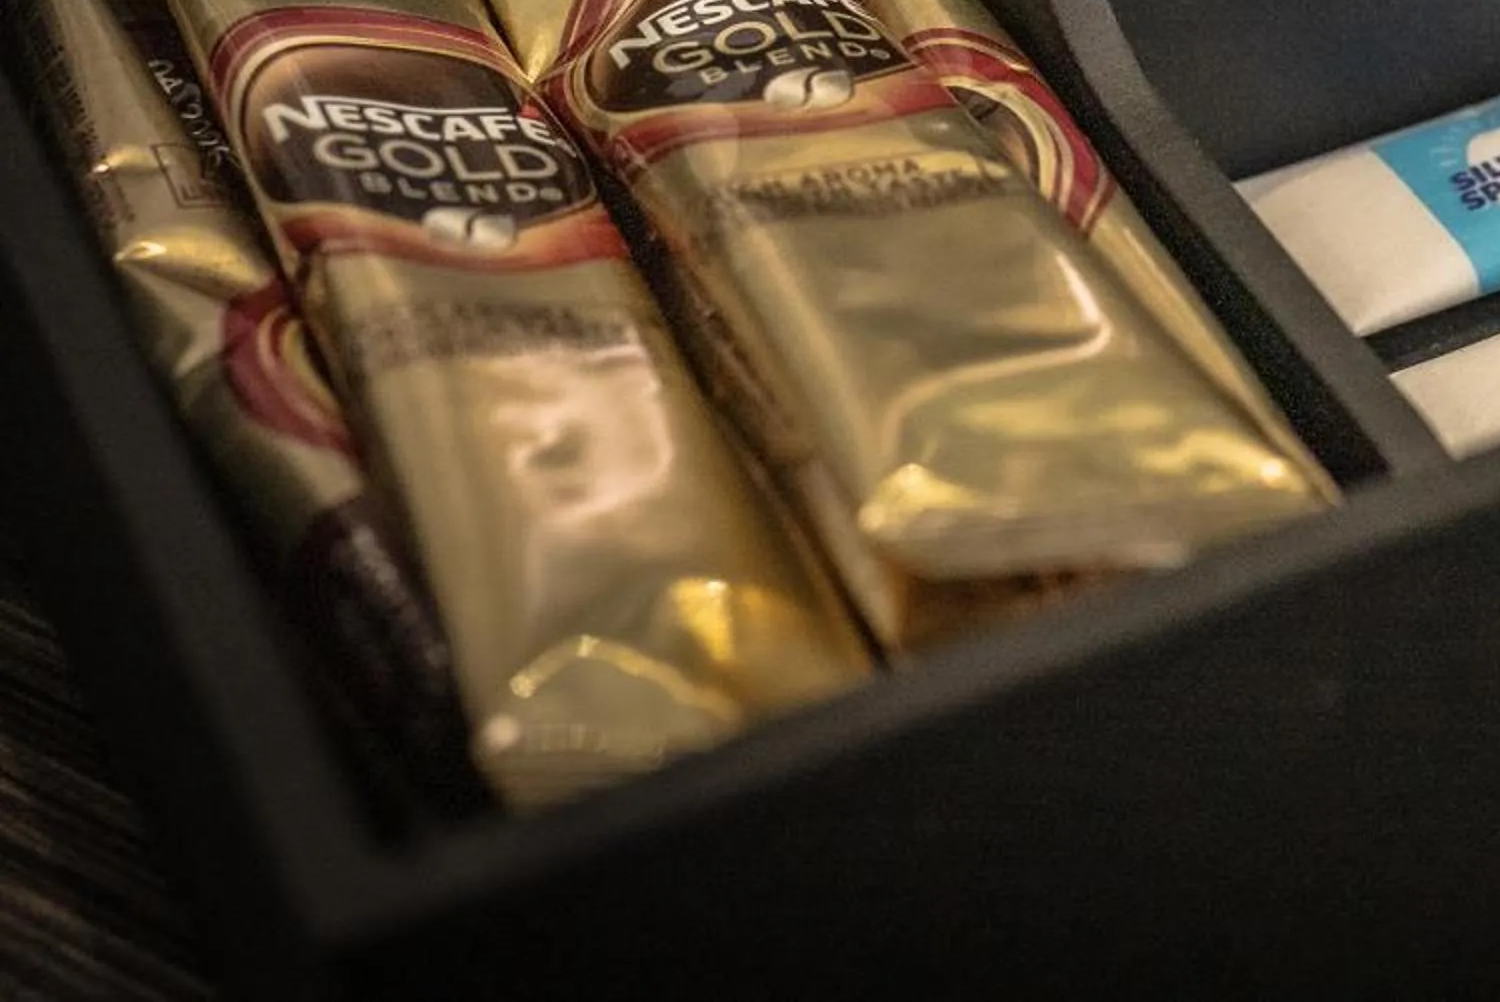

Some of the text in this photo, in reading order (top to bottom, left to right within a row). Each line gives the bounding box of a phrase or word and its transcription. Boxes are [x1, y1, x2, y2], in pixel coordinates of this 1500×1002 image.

[653, 9, 880, 75] GOLD
[700, 41, 867, 86] BLEND
[313, 133, 559, 181] GOLD
